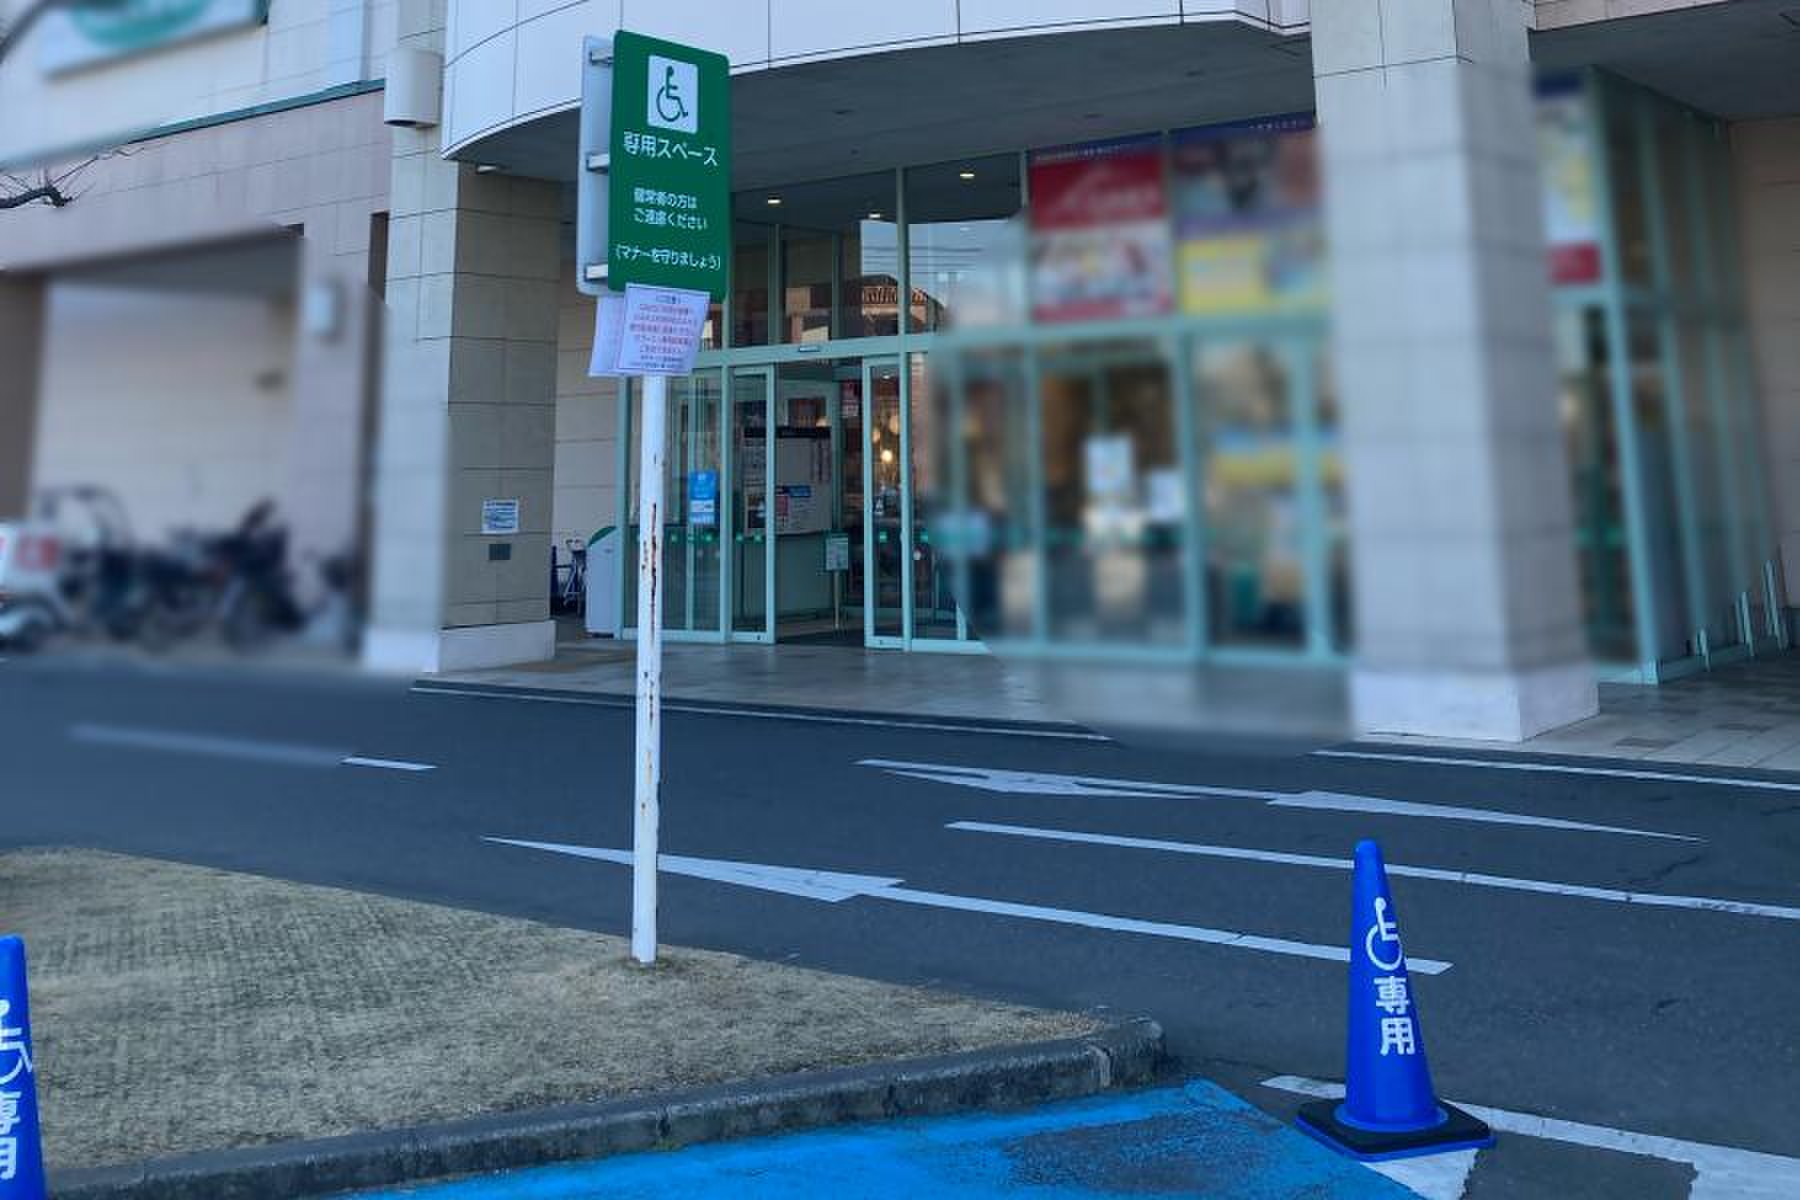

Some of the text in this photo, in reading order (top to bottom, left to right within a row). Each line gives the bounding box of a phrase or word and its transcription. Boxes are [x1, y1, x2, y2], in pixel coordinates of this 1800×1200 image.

[623, 131, 718, 166] 専用スペース
[1374, 975, 1415, 1056] 専用
